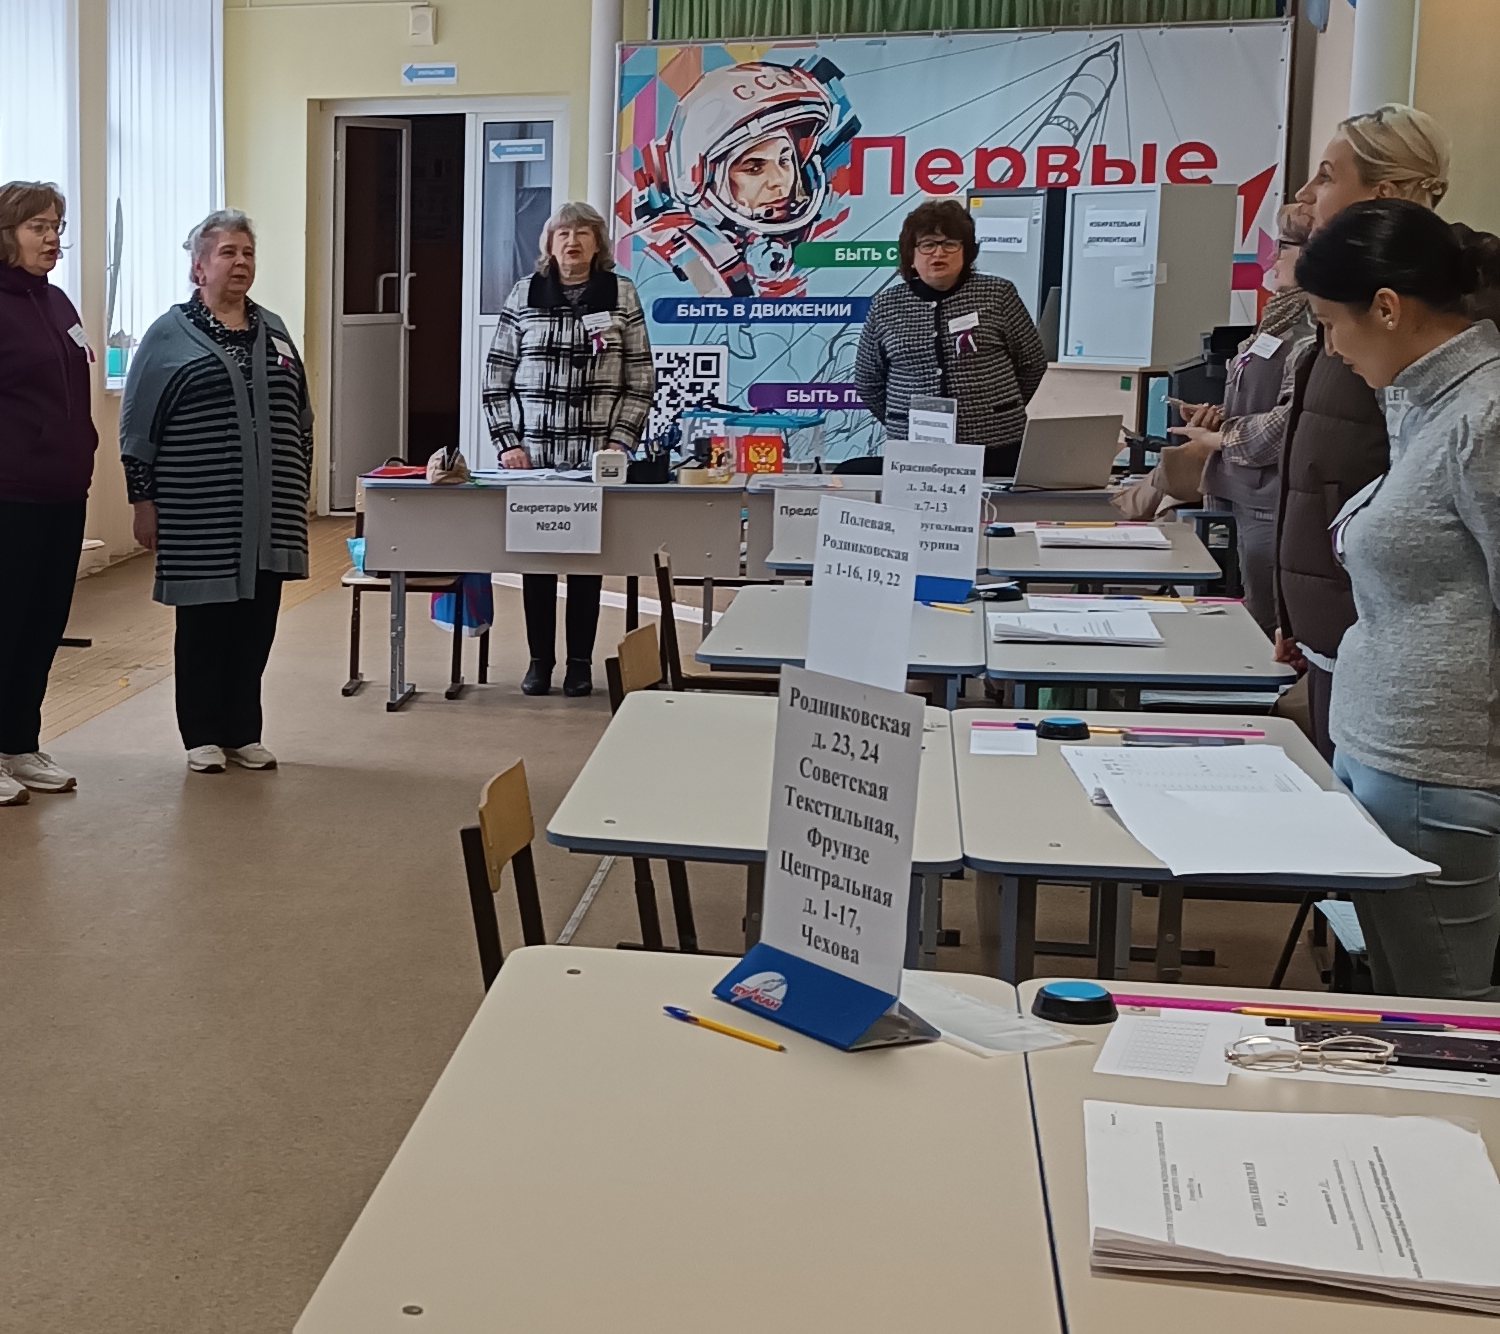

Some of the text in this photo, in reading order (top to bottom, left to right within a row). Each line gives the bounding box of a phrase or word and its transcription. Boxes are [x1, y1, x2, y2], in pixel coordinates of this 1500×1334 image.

[849, 135, 1219, 197] Первые
[835, 247, 883, 261] БЫТЬ
[676, 303, 852, 319] БЫТЬ В ДВИЖЕНИИ
[786, 390, 839, 403] БЫТЬ
[891, 461, 977, 477] Красноборская
[959, 483, 966, 495] 4
[509, 502, 598, 515] Секретарь УИК
[536, 521, 572, 531] №240
[822, 534, 909, 562] Родниковская
[836, 562, 863, 582] 1-16,
[867, 568, 883, 586] 19,
[886, 571, 901, 587] 22
[789, 686, 911, 738] Родниковская
[811, 732, 879, 764] д. 23, 24
[799, 756, 889, 802] Советская
[784, 784, 900, 844] Текстильная,
[807, 826, 870, 865] Фрунзе
[780, 849, 893, 908] Центральная
[802, 897, 861, 936] д. 1-17,
[801, 923, 860, 965] Чехова
